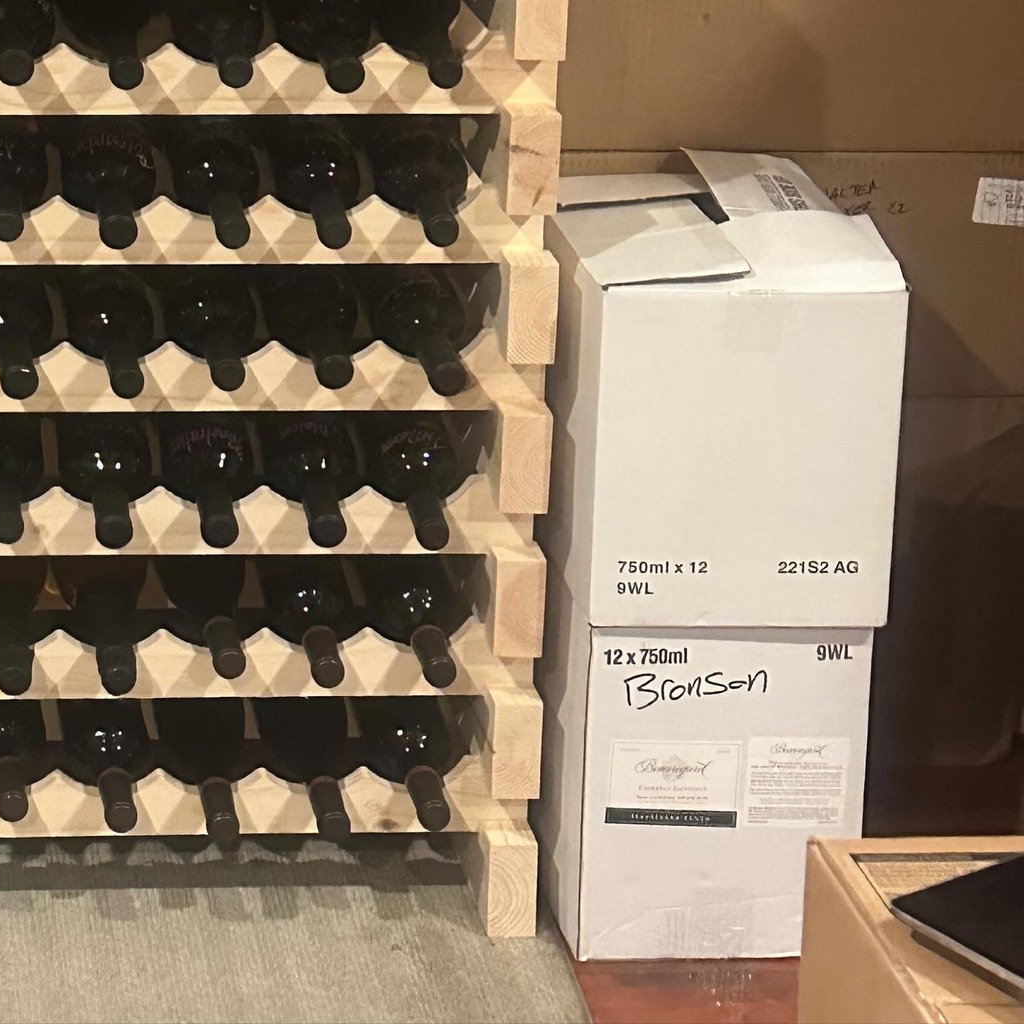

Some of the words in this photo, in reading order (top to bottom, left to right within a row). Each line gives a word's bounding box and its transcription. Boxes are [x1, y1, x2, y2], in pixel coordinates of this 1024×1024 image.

[618, 561, 669, 574] 750ml
[675, 564, 684, 574] x
[689, 561, 708, 574] 12
[778, 561, 829, 574] 221S2
[834, 561, 859, 574] AG
[617, 581, 654, 595] 9WL
[604, 650, 623, 665] 12
[626, 652, 636, 665] x
[640, 648, 688, 665] 750ml
[816, 644, 853, 661] 9WL
